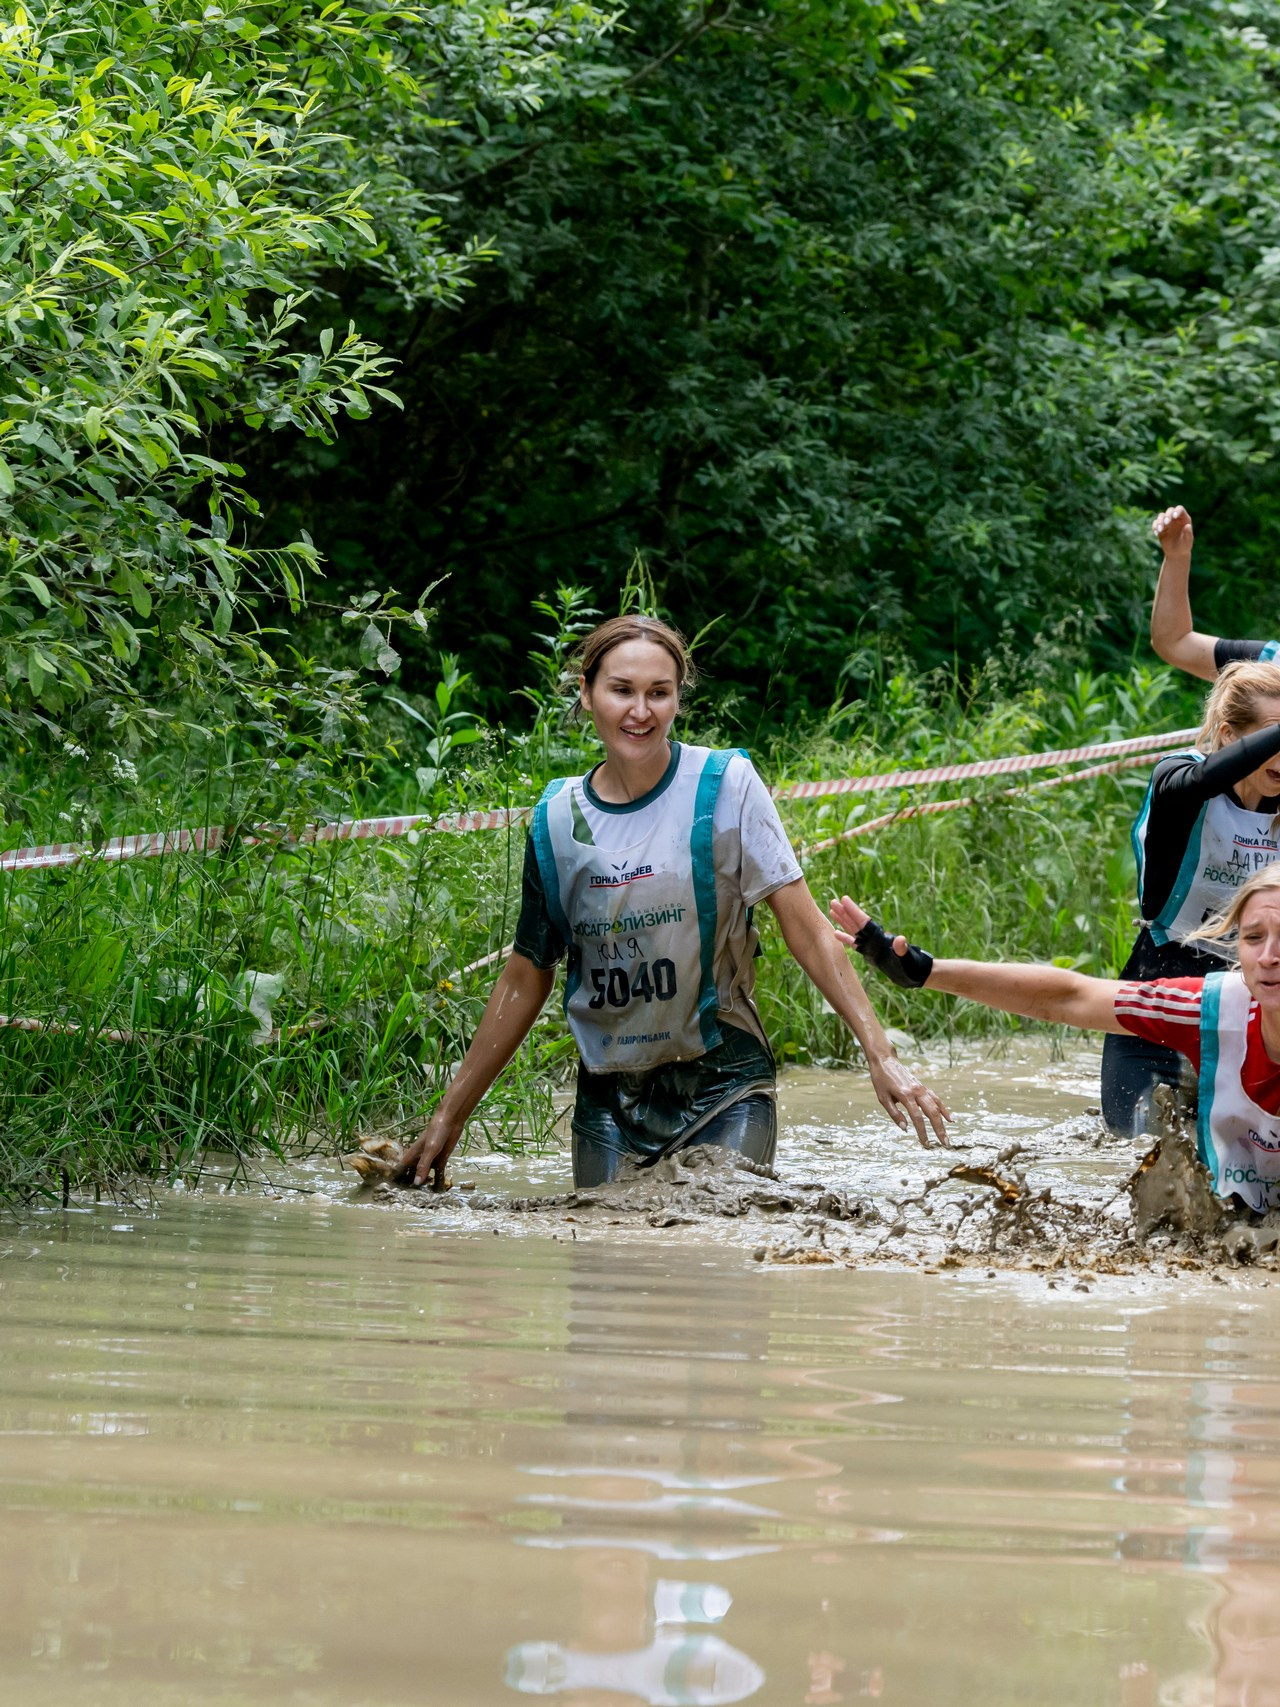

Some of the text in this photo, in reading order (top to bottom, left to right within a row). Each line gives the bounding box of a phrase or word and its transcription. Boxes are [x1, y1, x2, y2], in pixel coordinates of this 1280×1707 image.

[1234, 834, 1259, 846] ГОНКА
[590, 875, 619, 885] ГОНКА
[588, 958, 677, 1009] 5040
[617, 1031, 671, 1045] ГАЗПРОМБАНК
[1248, 1129, 1274, 1149] ГОНКА
